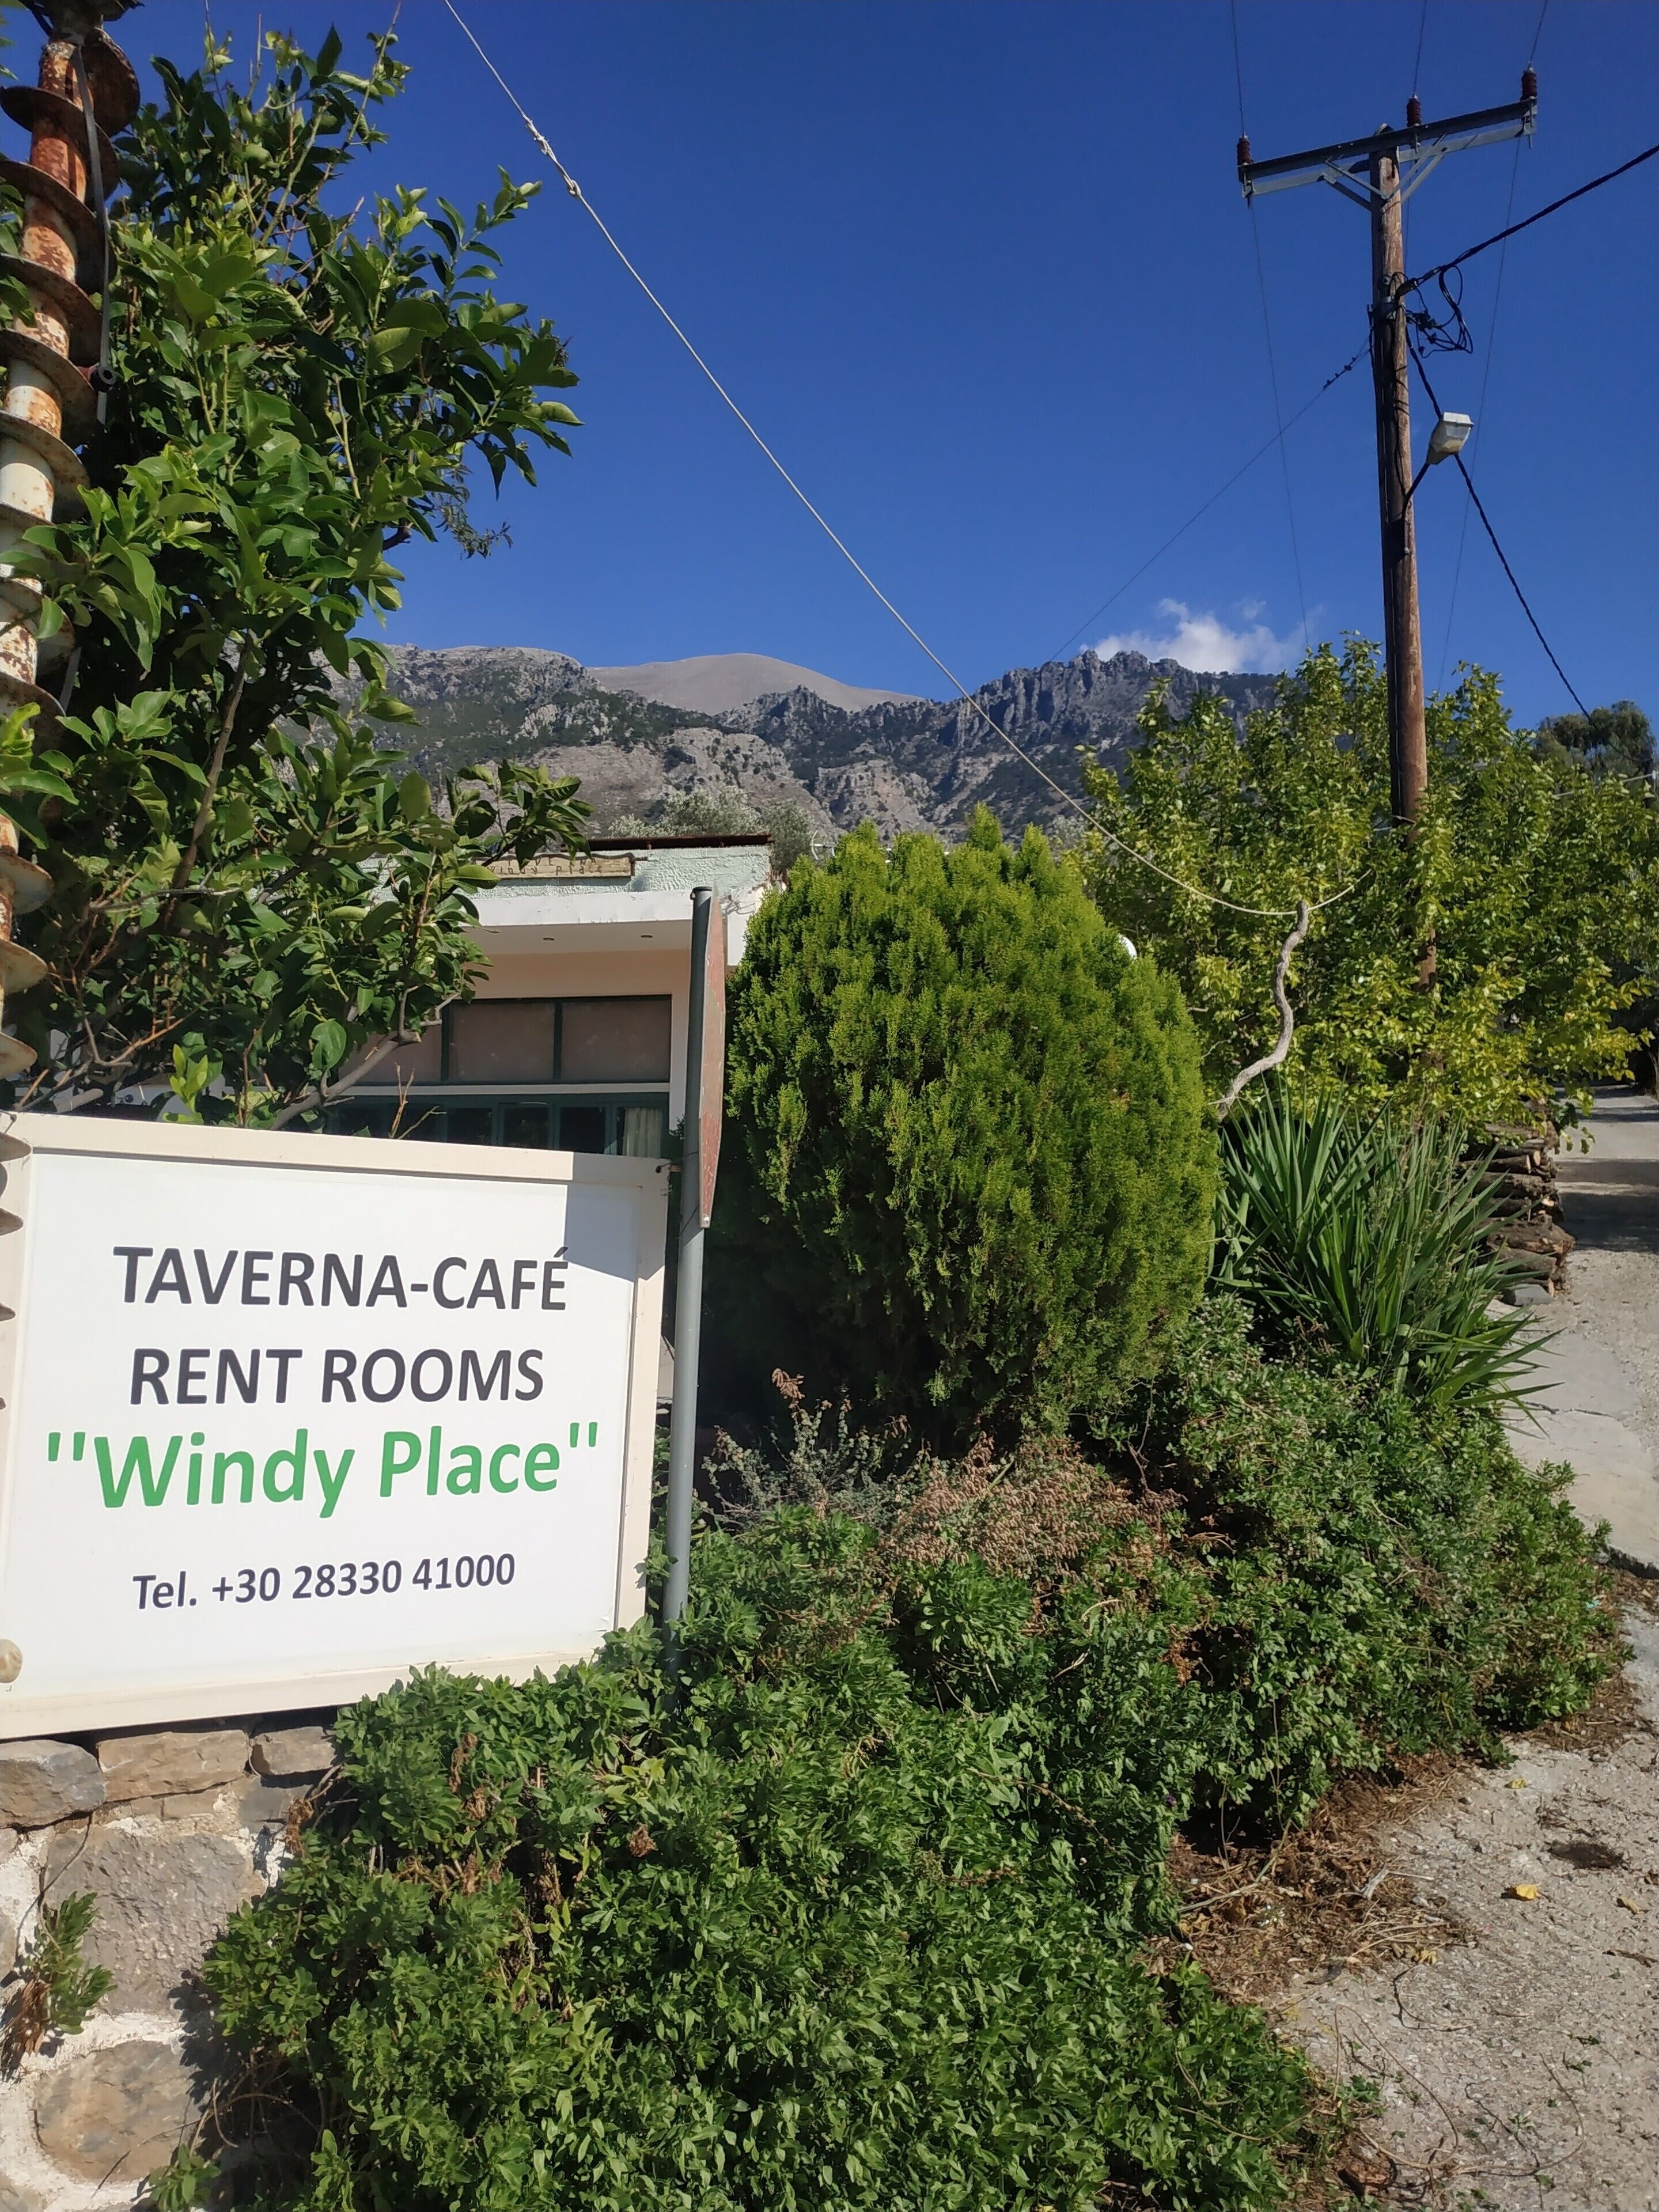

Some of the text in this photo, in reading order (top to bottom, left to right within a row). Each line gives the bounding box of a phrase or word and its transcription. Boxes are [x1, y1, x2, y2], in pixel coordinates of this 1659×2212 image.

[113, 1246, 569, 1310] TAVERNA-CAFÉ
[130, 1349, 543, 1405] RENT ROOMS
[133, 1553, 515, 1609] Tel. +30 28330 41000
